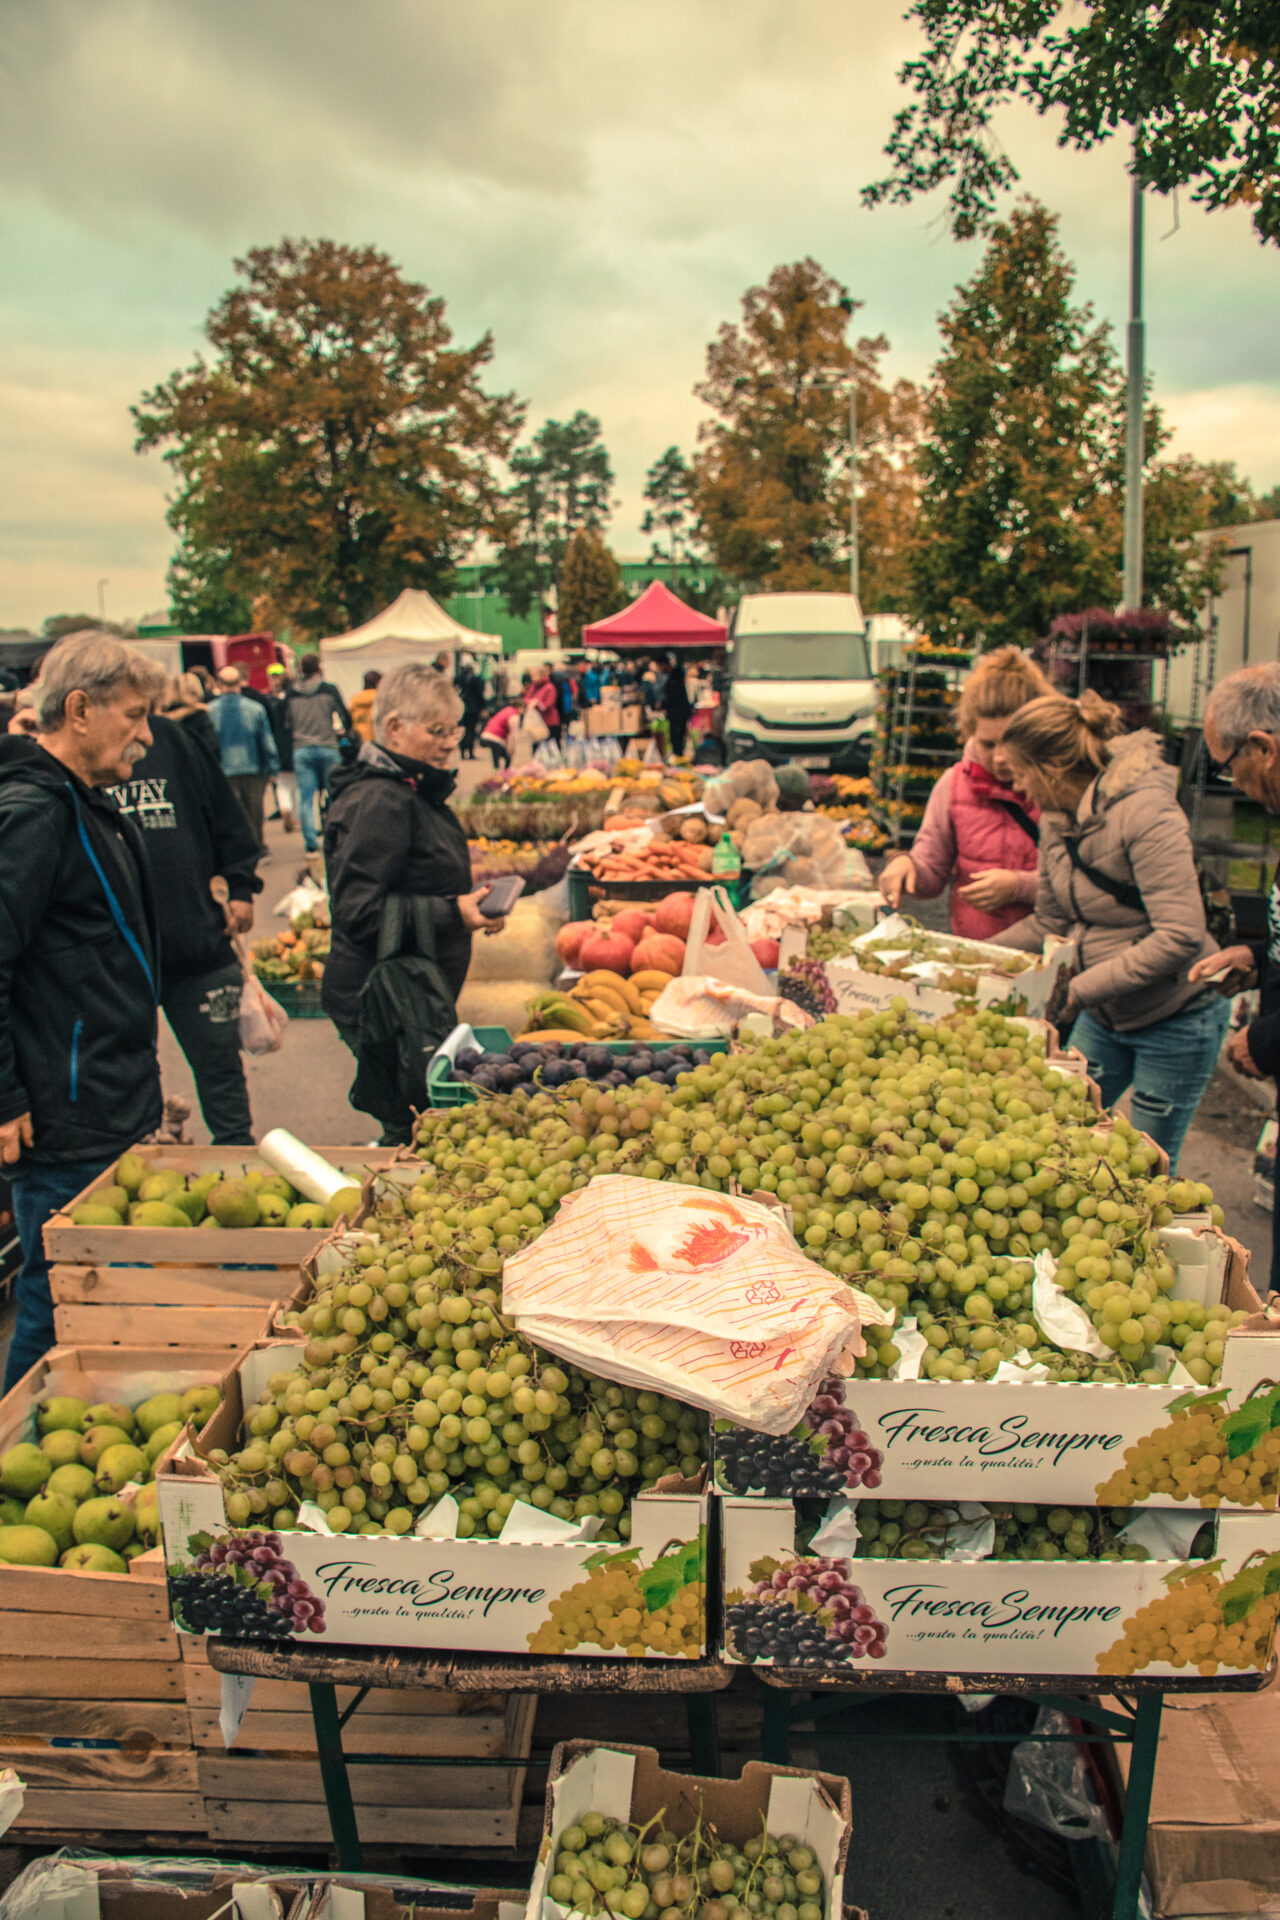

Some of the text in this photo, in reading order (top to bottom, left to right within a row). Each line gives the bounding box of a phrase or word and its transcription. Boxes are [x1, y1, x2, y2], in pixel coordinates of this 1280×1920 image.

[878, 1408, 1124, 1467] Fresca Sempre
[959, 1455, 975, 1468] la
[315, 1561, 548, 1618] Fresca Sempre
[396, 1605, 411, 1617] la
[883, 1584, 1122, 1638] Fresca Sempre
[962, 1628, 977, 1640] la
